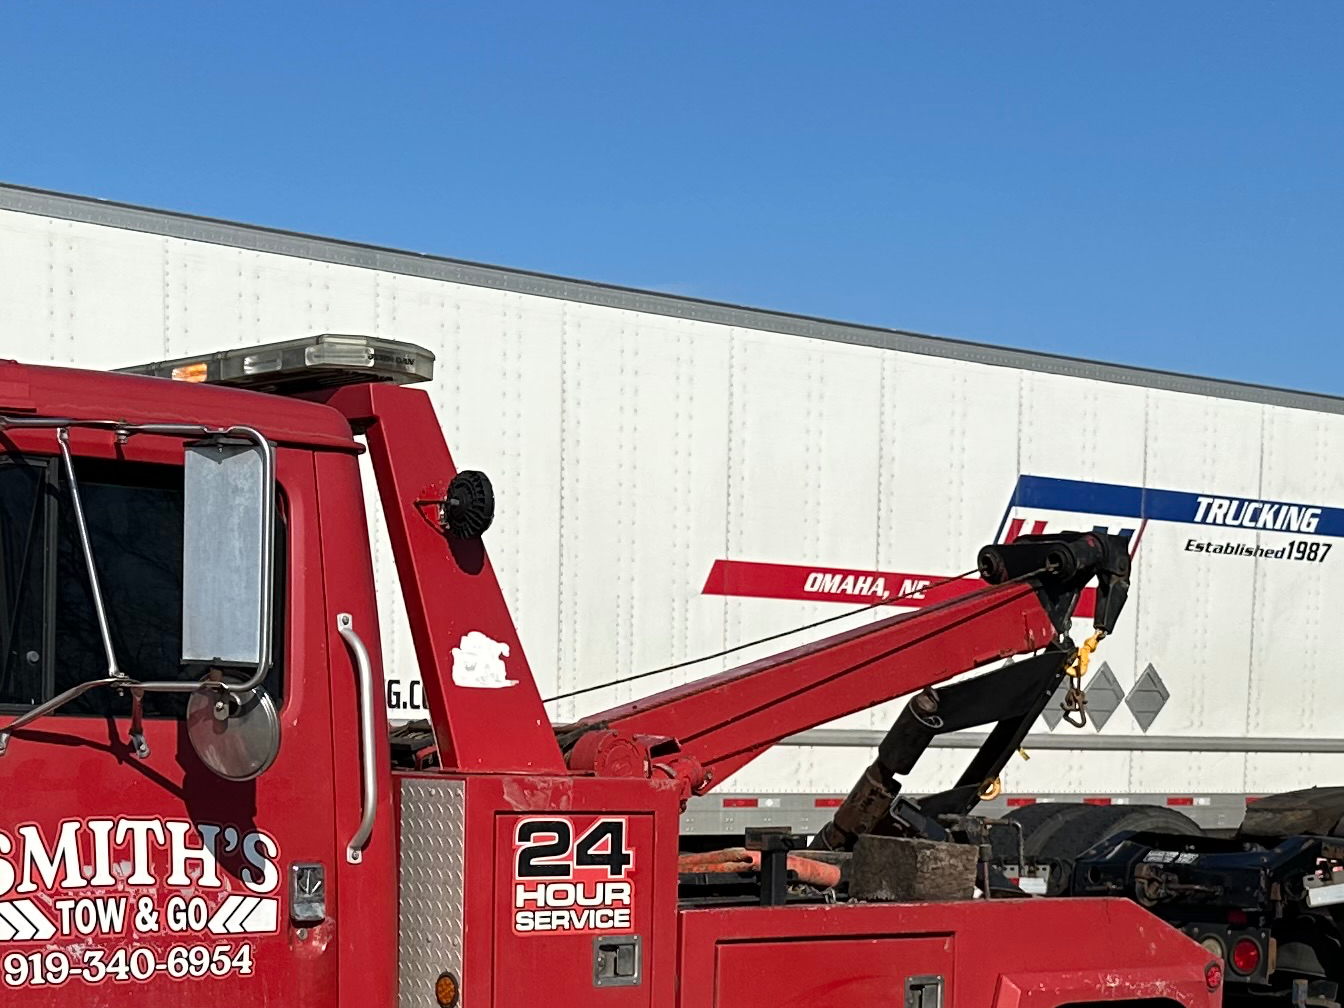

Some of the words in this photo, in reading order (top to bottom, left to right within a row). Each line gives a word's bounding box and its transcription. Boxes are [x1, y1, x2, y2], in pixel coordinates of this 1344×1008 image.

[1193, 496, 1322, 533] TRUCKING
[1184, 539, 1287, 560] Established
[1287, 540, 1333, 563] 1987
[804, 572, 891, 599] OMAHA,
[515, 818, 633, 880] 24
[515, 882, 632, 909] HOUR
[55, 898, 128, 936] TOW
[135, 898, 159, 932] &
[167, 897, 208, 932] GO
[515, 909, 631, 932] SERVICE
[4, 945, 253, 986] 919-340-6954
